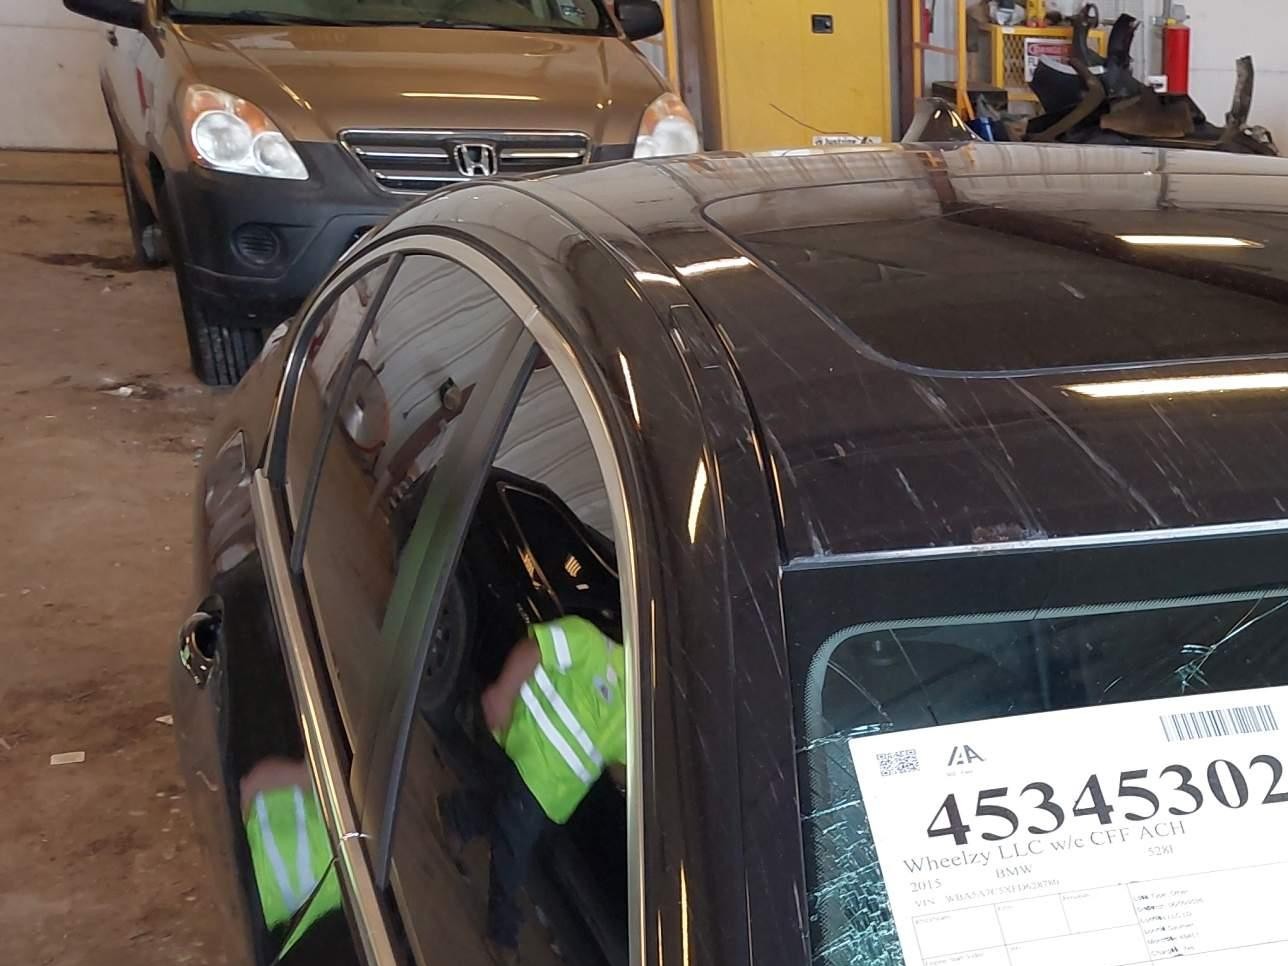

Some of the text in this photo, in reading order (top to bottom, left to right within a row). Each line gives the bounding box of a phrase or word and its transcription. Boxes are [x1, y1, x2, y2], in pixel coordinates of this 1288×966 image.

[903, 846, 991, 874] Wheelzy
[998, 839, 1044, 860] LLC
[1088, 829, 1130, 848] CFF
[1139, 820, 1187, 840] ACH
[910, 878, 942, 893] 2015
[995, 863, 1033, 879] BMW
